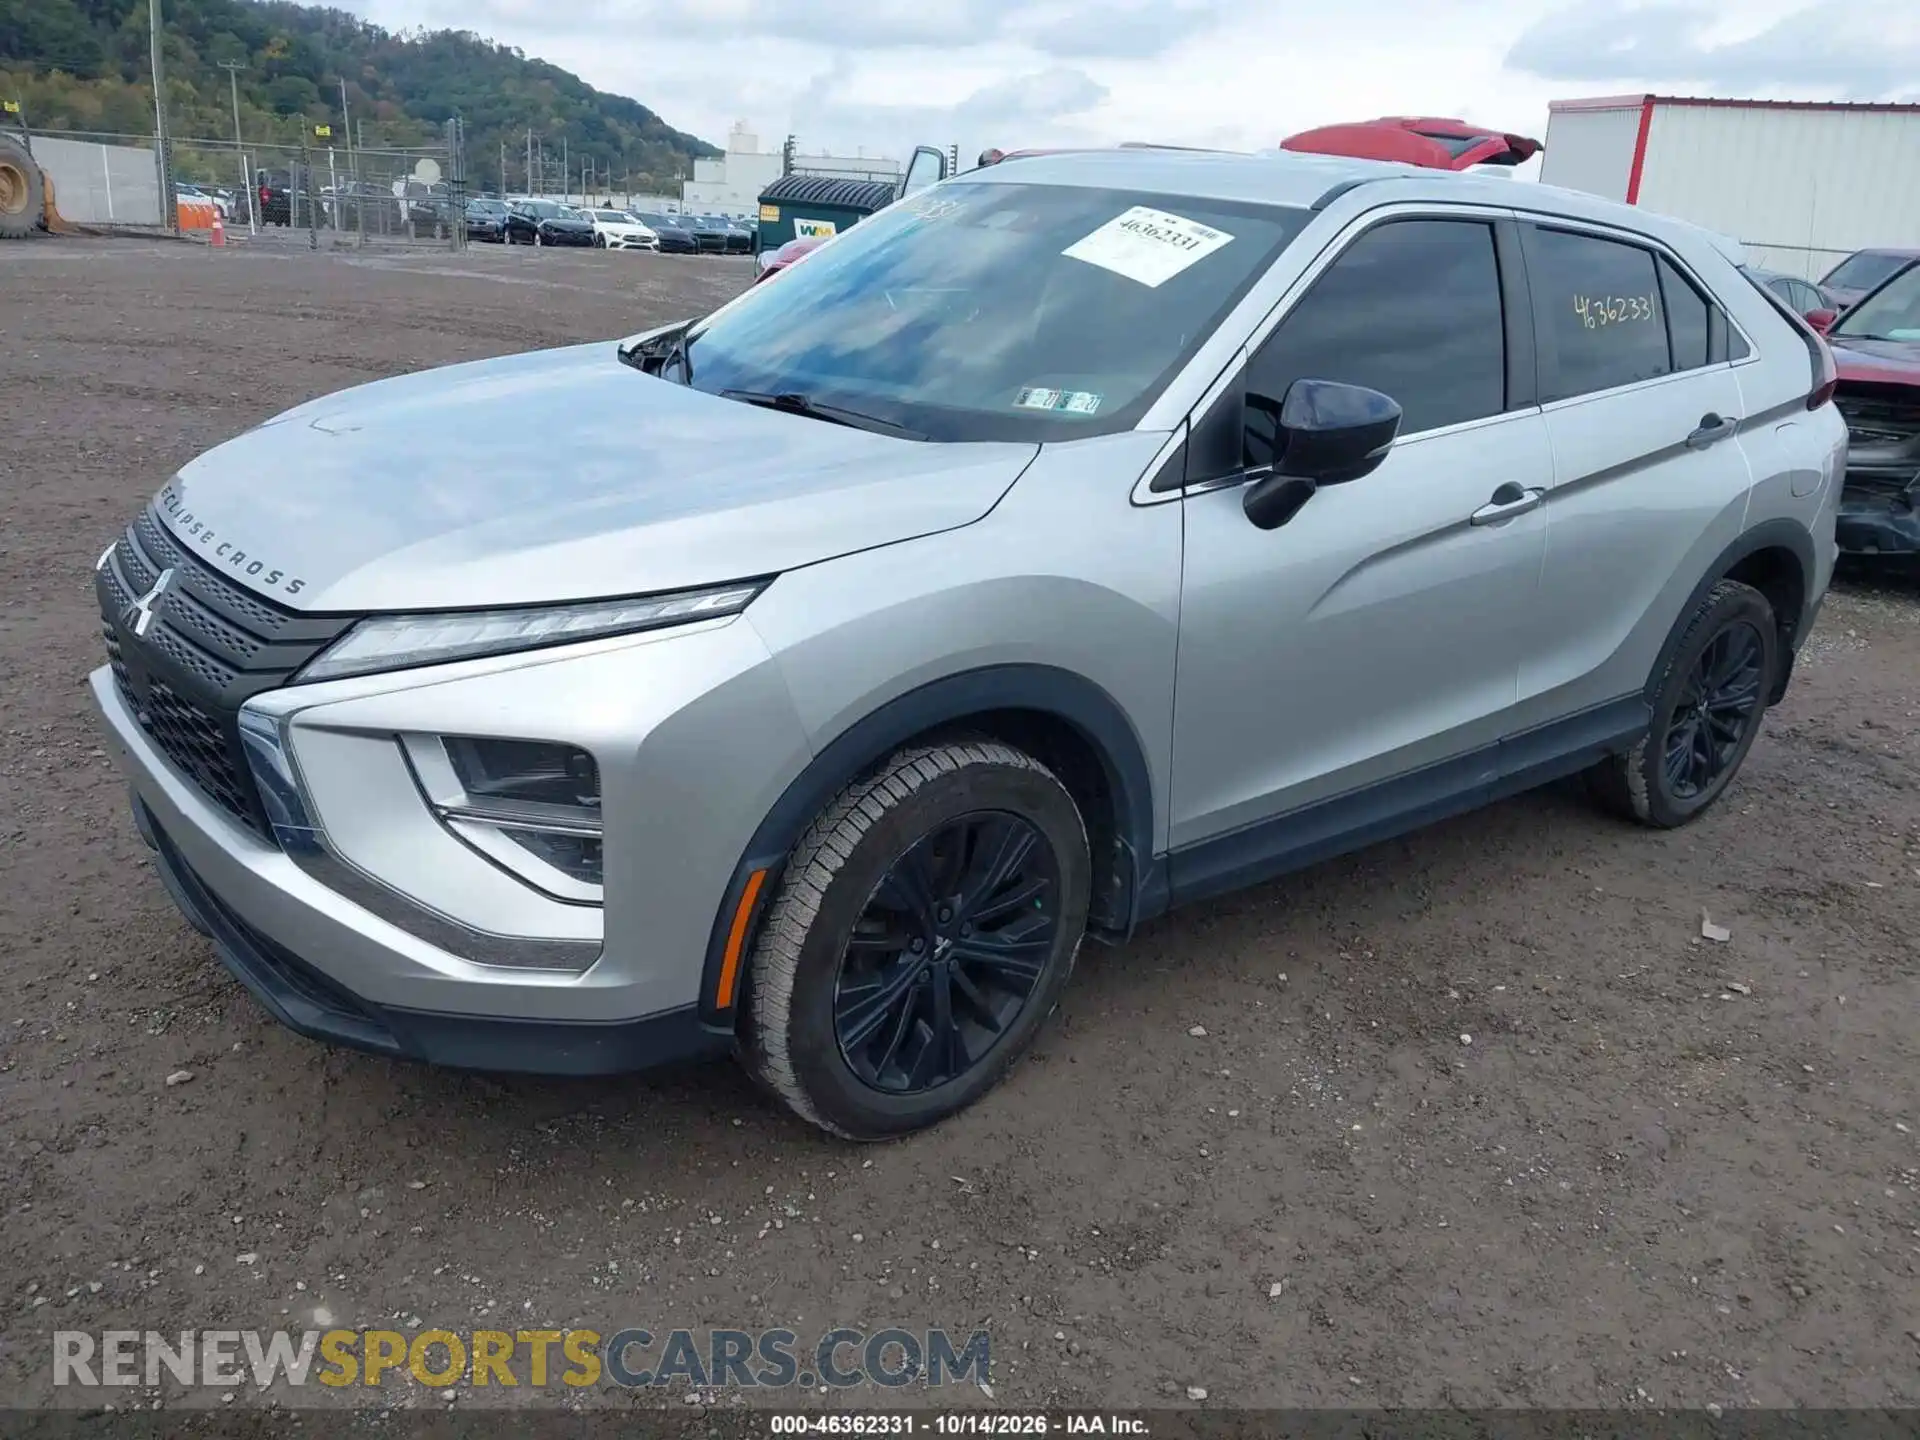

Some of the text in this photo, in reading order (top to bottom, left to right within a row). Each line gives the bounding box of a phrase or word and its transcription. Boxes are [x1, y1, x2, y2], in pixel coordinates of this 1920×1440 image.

[800, 224, 833, 237] WM
[1119, 219, 1201, 251] 46362331
[1573, 291, 1657, 329] 46362331
[161, 486, 307, 594] ECLIPSE CROSS
